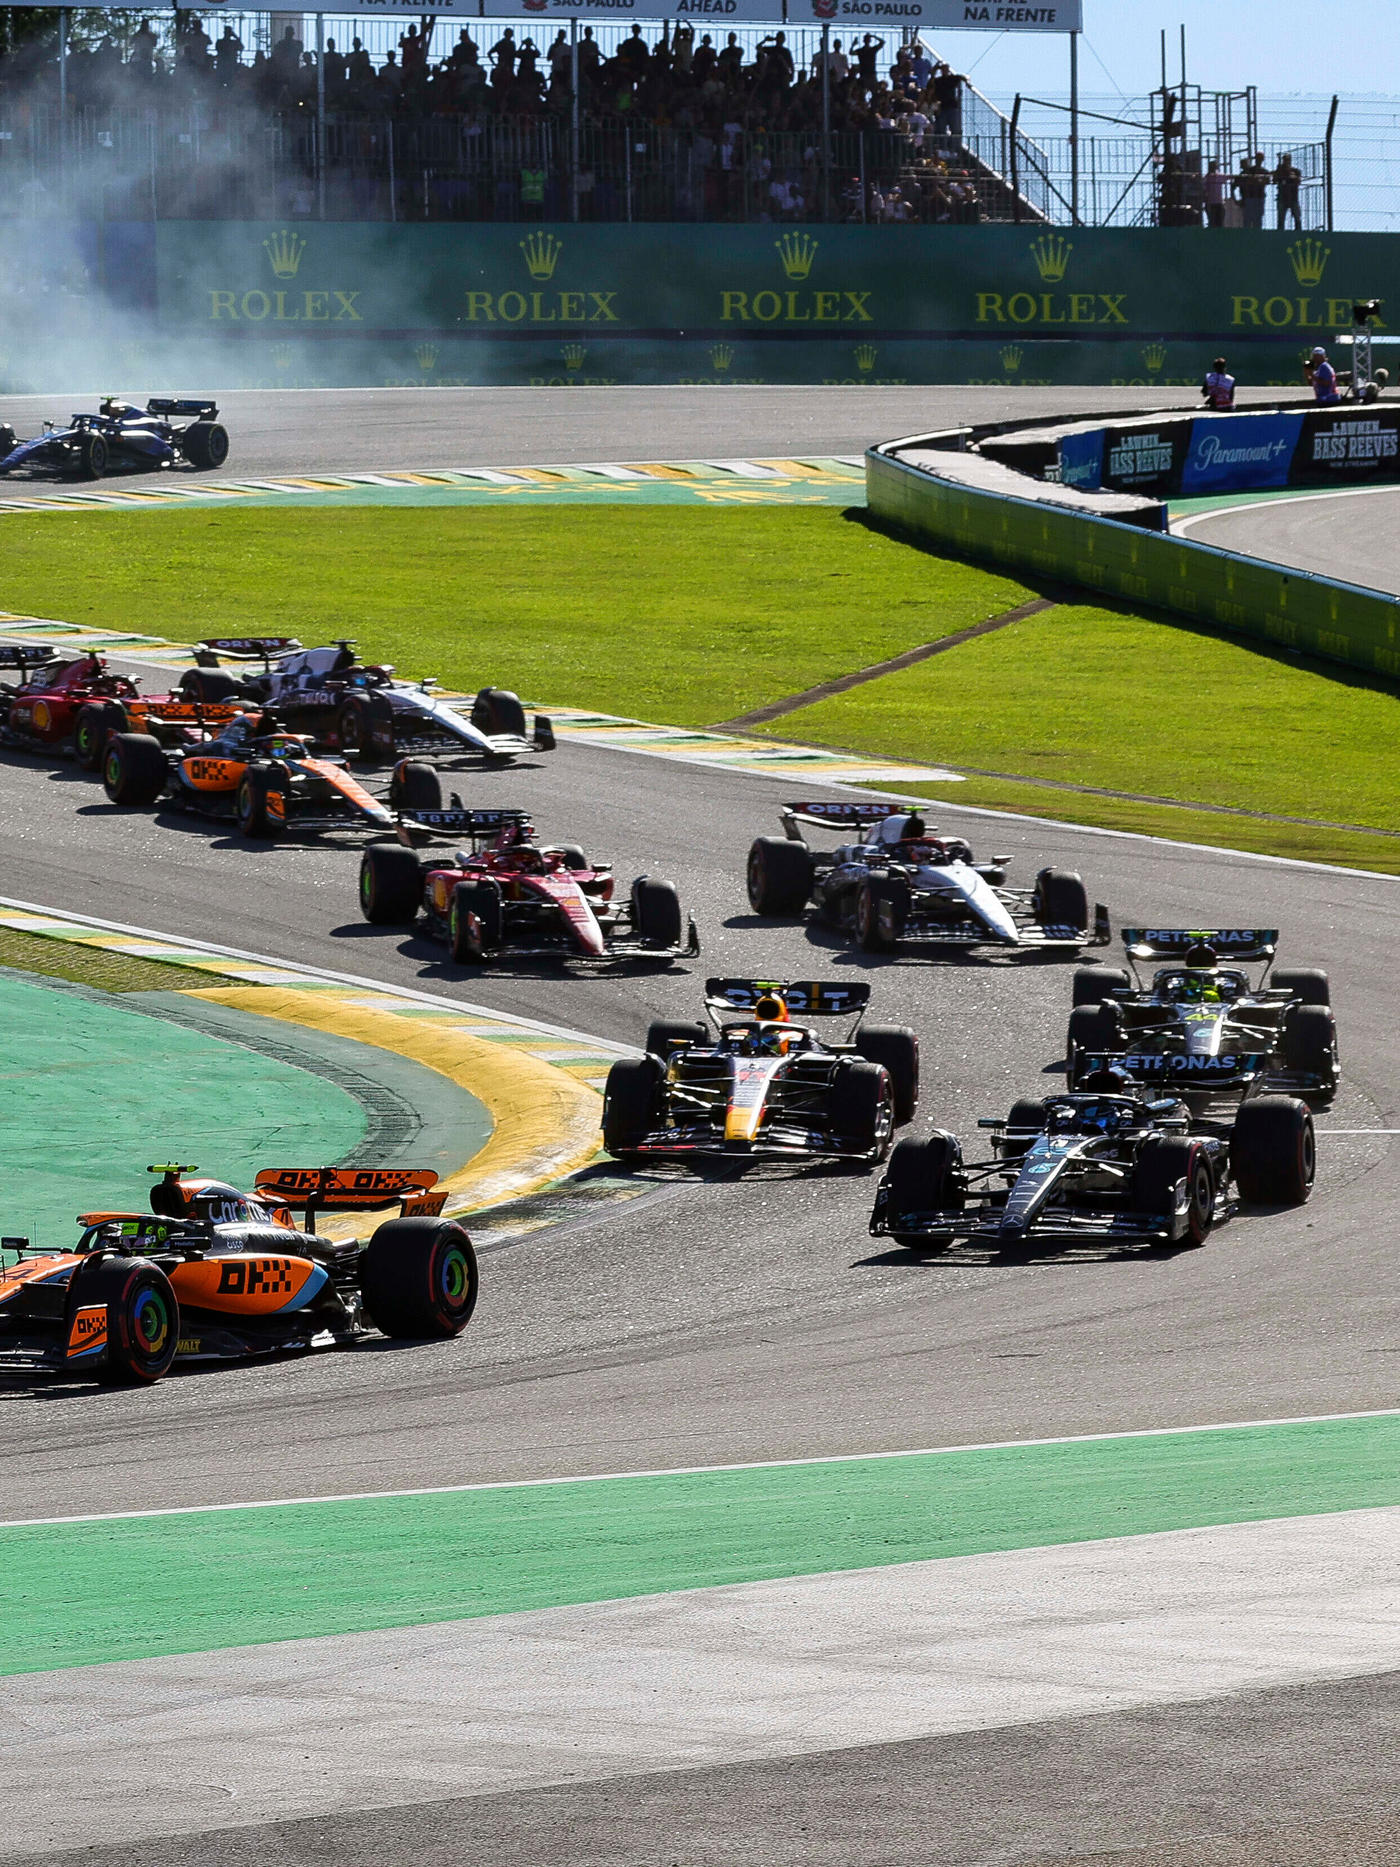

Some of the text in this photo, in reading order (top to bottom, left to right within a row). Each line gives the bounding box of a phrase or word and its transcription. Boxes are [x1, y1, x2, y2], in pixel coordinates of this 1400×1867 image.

[676, 0, 737, 13] AHEAD
[875, 3, 922, 16] PAULO
[964, 7, 1056, 23] NA FRENTE
[208, 290, 363, 321] ROLEX
[464, 291, 620, 322] ROLEX
[720, 290, 874, 321] ROLEX
[975, 292, 1129, 324] ROLEX
[1136, 447, 1173, 473] REEVES
[1313, 435, 1398, 460] BASS REEVES
[216, 1259, 292, 1295] OKX
